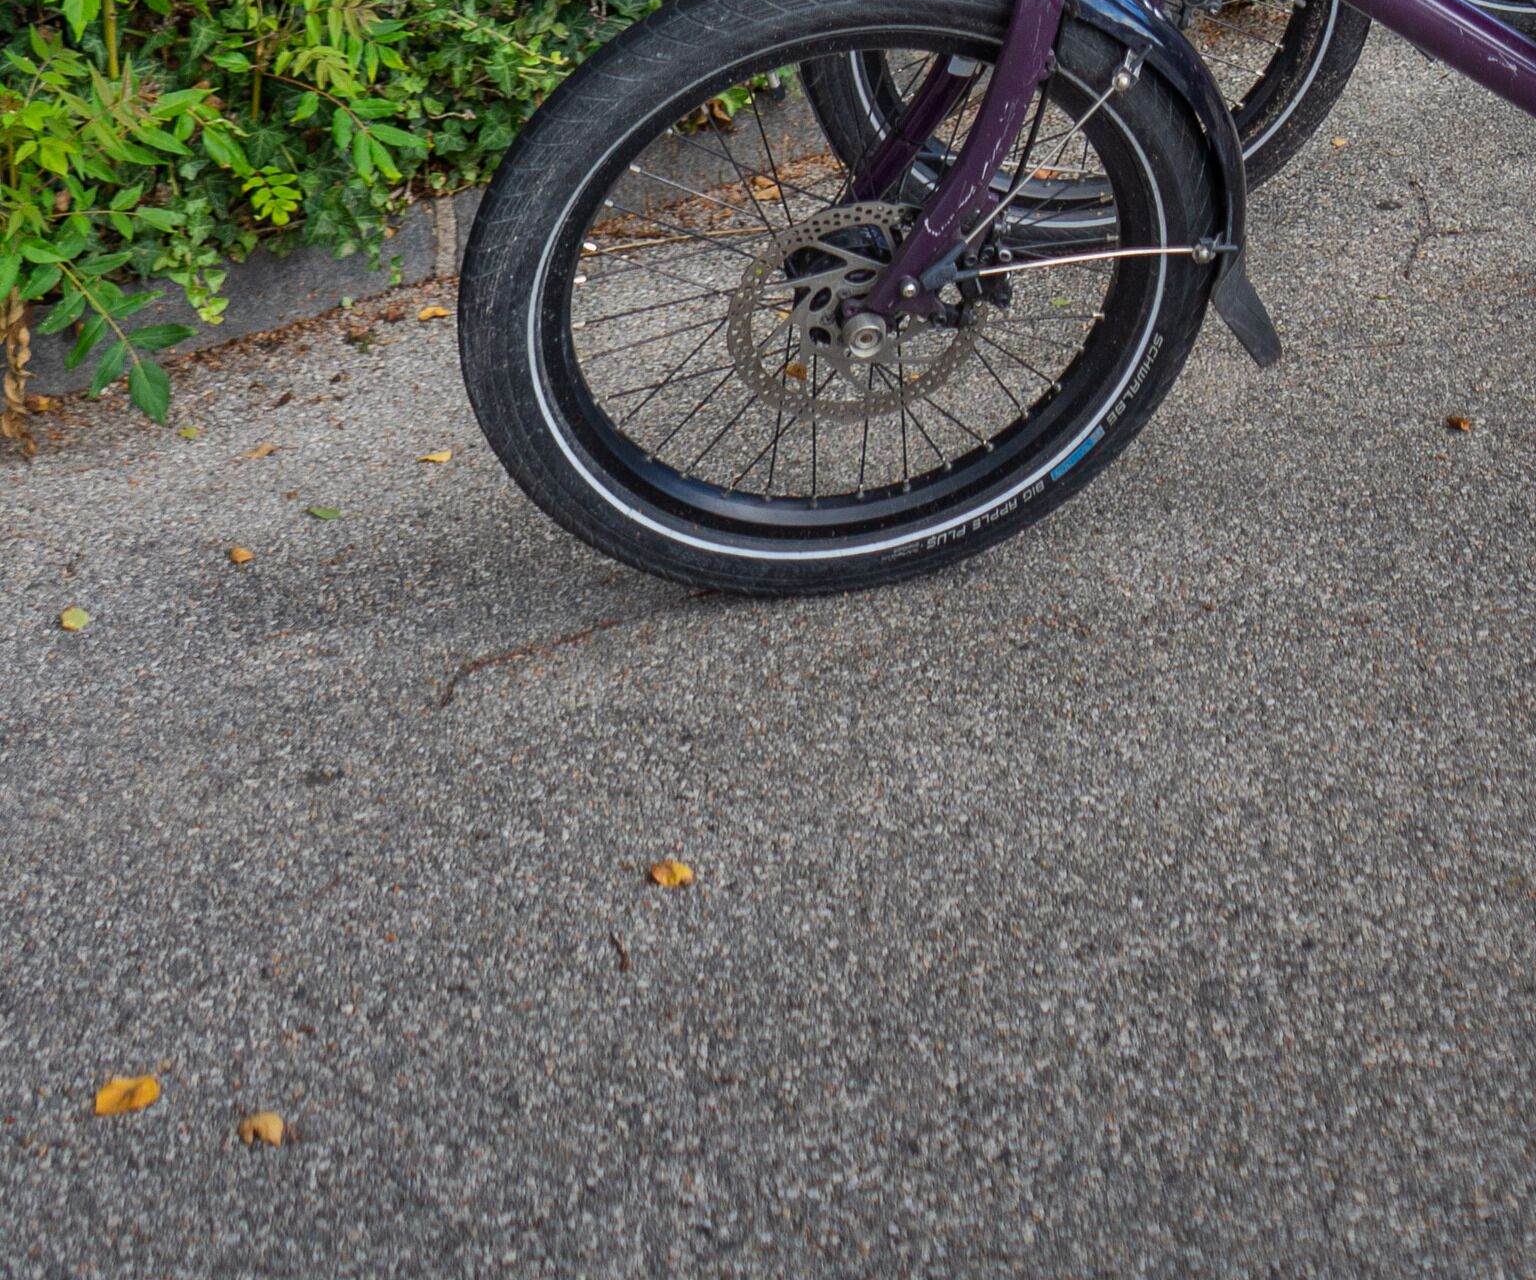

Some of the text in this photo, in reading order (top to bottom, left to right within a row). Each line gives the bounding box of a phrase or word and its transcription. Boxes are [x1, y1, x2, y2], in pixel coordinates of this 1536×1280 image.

[1105, 332, 1164, 427] SCHWALBE
[925, 480, 1046, 551] BIG APPLE PLUS
